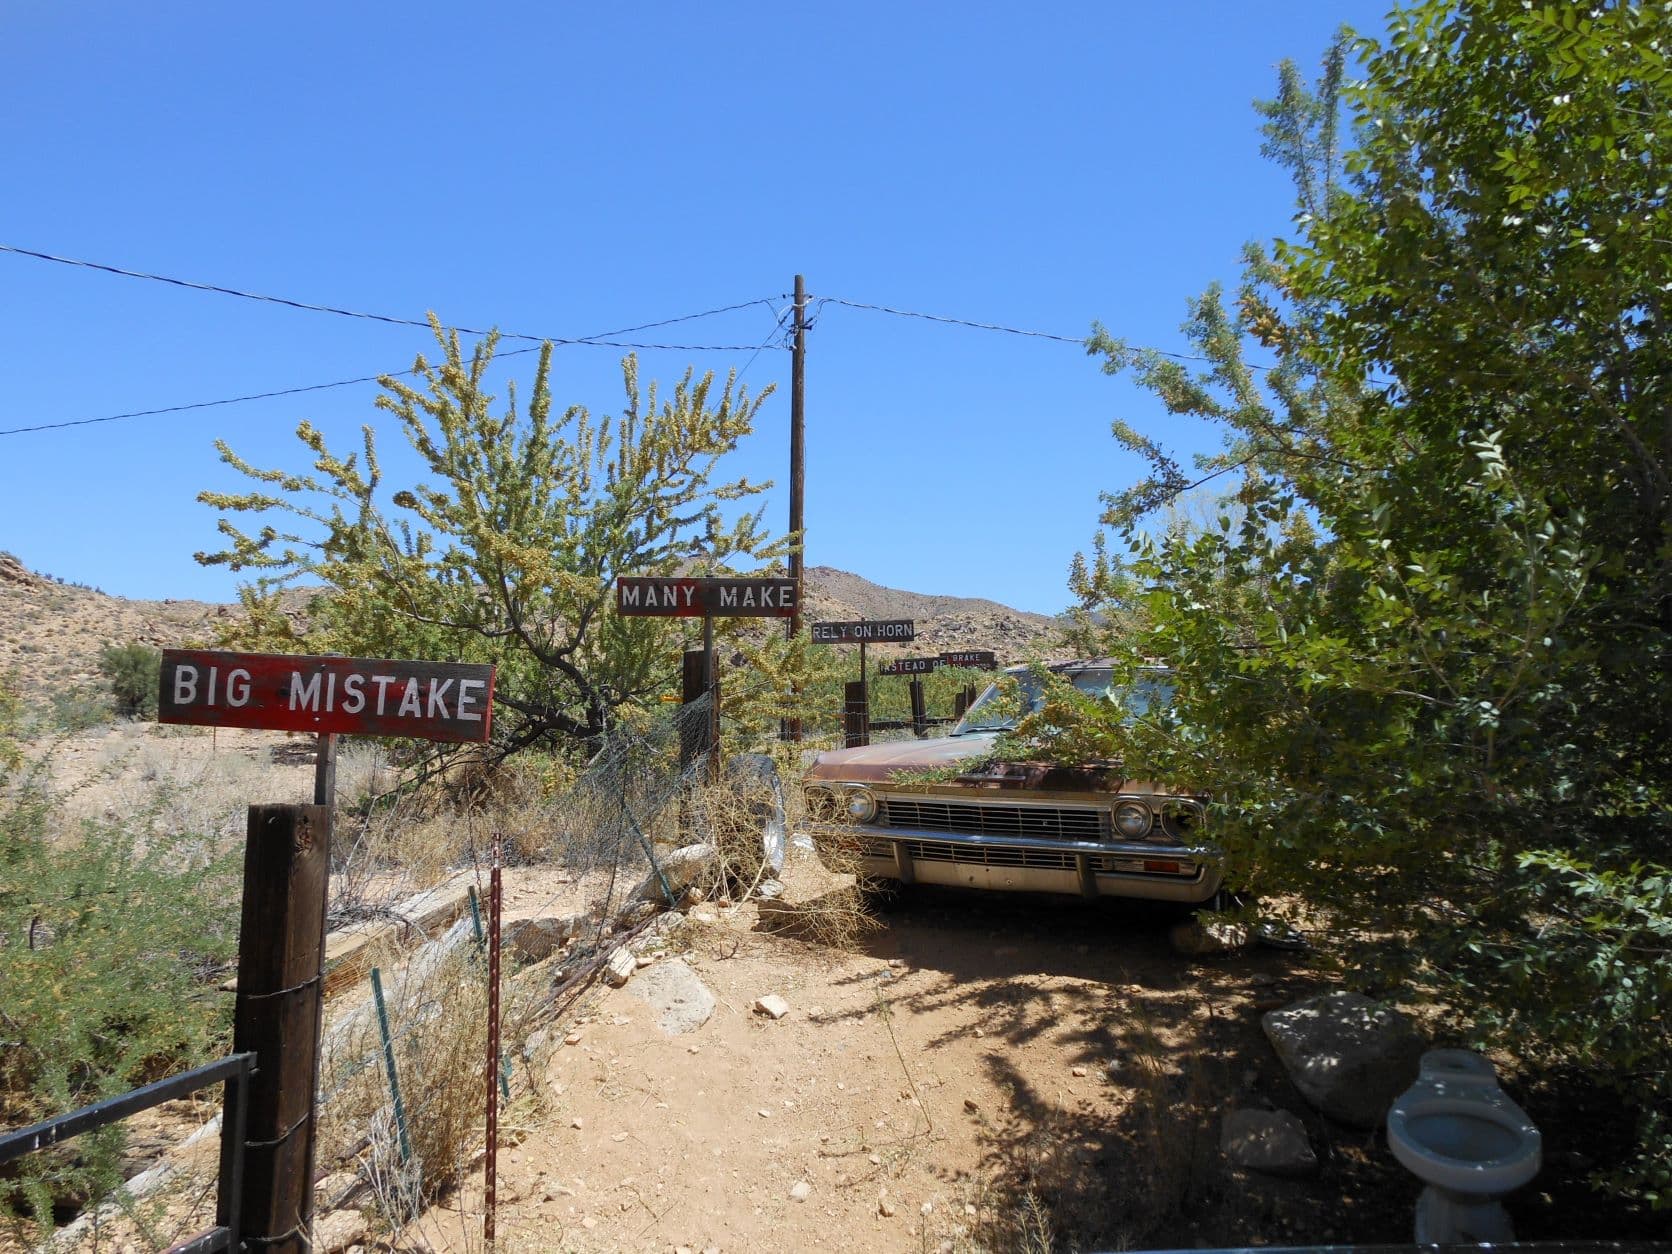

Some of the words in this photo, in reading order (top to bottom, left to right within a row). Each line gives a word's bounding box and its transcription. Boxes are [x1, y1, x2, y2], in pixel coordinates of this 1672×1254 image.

[622, 585, 695, 607] MANY
[720, 585, 793, 607] MAKE
[813, 626, 848, 639] RELY
[854, 625, 872, 638] ON
[877, 623, 913, 637] HORN
[932, 659, 946, 670] OF
[952, 653, 980, 662] BRAKE
[174, 664, 251, 707] BIG
[289, 671, 485, 721] MISTAKE
